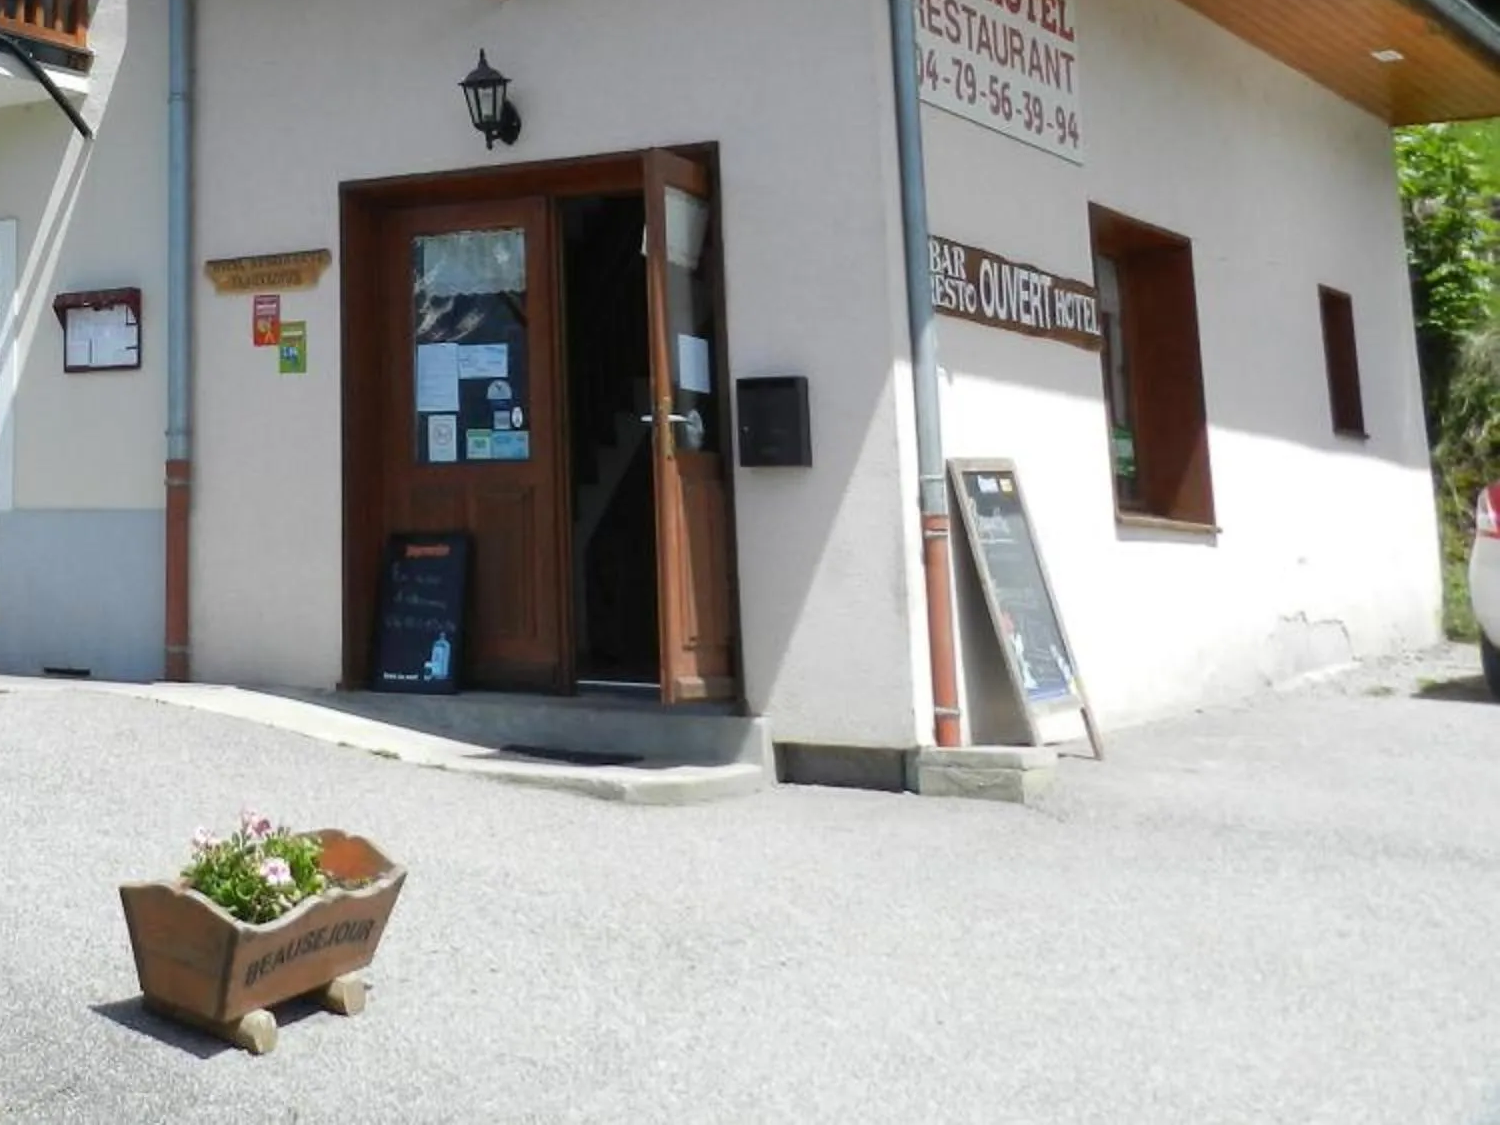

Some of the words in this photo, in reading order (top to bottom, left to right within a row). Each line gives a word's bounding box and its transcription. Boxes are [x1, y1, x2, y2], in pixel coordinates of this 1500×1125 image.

[928, 239, 967, 280] BAR
[979, 258, 1052, 330] OUVERT
[1054, 289, 1101, 336] HOTEL
